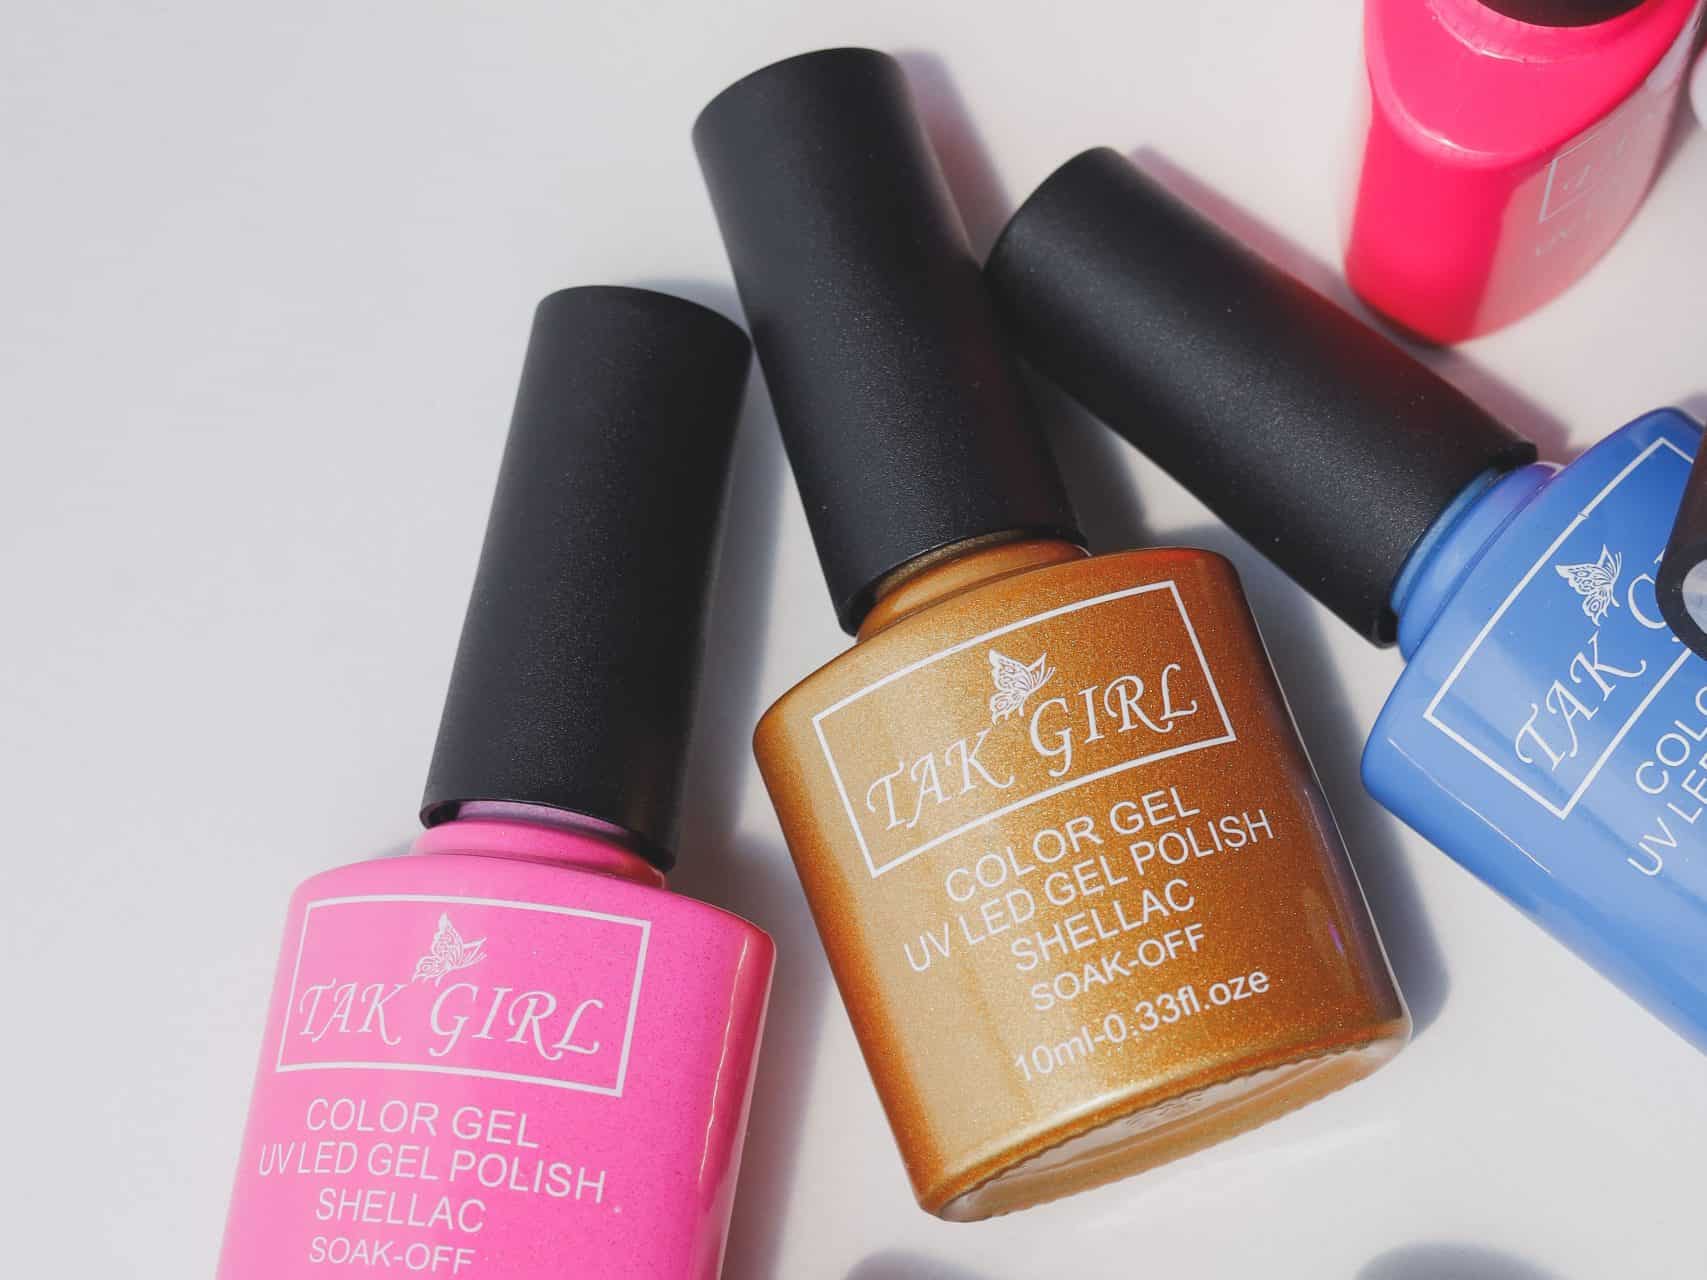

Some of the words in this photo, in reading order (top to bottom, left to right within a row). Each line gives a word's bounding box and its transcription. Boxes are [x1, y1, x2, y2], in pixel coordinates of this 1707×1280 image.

[867, 729, 1014, 830] TAK
[1030, 663, 1197, 777] GIRL
[1515, 634, 1646, 770] TAK
[945, 815, 1104, 901] COLOR
[1110, 787, 1200, 836] GEL
[1627, 816, 1677, 876] UV
[1667, 753, 1707, 824] LE
[904, 922, 952, 972] UV
[961, 889, 1035, 947] LED
[1043, 855, 1128, 908] GEL
[1132, 809, 1274, 873] POLISH
[1012, 878, 1195, 970] SHELLAC
[1031, 923, 1205, 1011] SOAK-OFF
[299, 979, 408, 1046] TAK
[428, 981, 603, 1060] GIRL
[1015, 970, 1270, 1082] 10ml-0.33fl.oze
[306, 1098, 439, 1136] COLOR
[452, 1106, 539, 1148] GEL
[259, 1142, 296, 1175] UV
[297, 1142, 357, 1175] LED
[368, 1144, 438, 1180] GEL
[450, 1150, 605, 1204] POLISH
[315, 1188, 486, 1233] SHELLAC
[309, 1236, 474, 1275] SOAK-OFF
